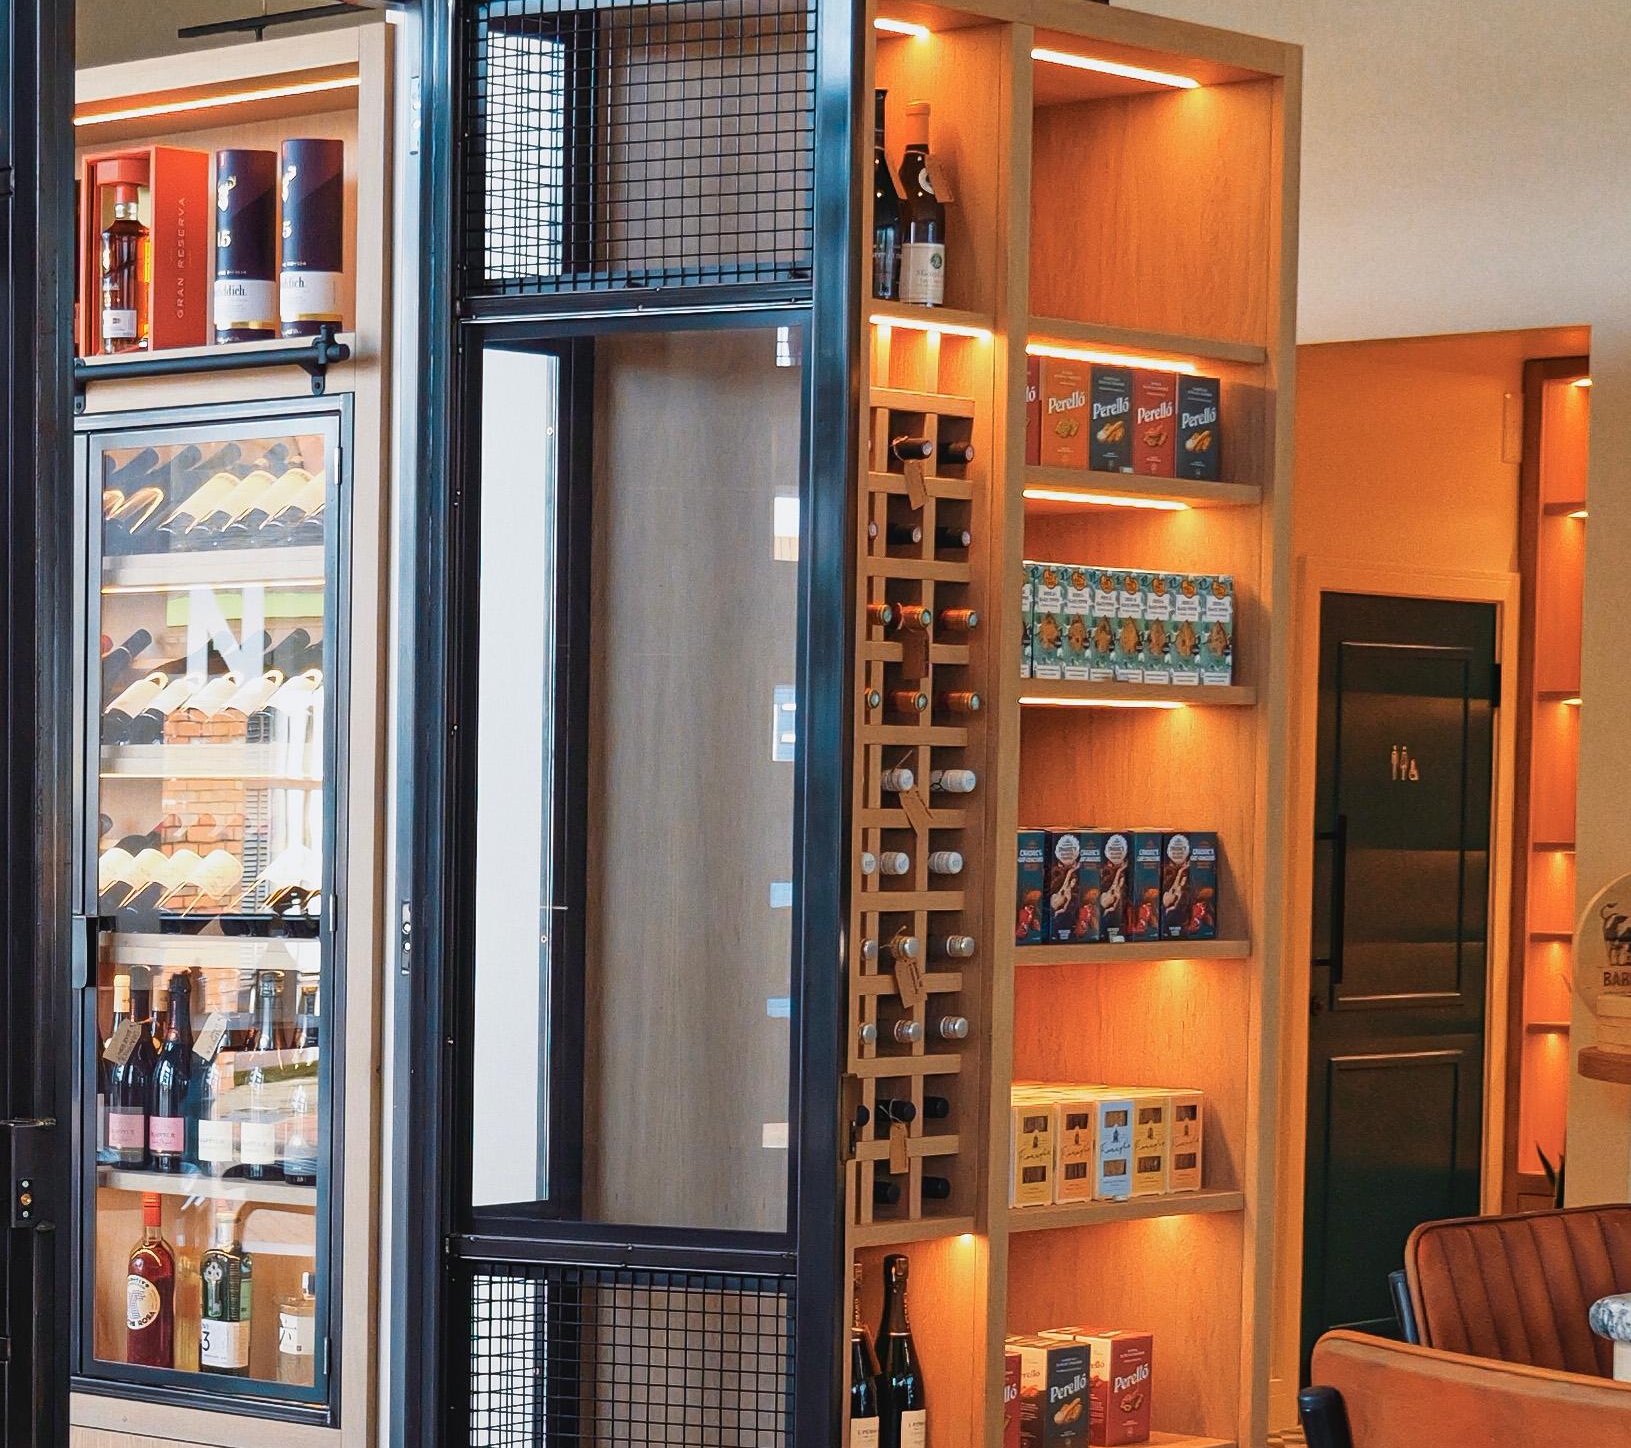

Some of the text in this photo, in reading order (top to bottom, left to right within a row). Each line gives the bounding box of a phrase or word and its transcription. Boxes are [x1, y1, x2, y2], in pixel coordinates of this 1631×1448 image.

[217, 229, 232, 248] 15
[282, 220, 293, 239] 5
[176, 198, 186, 319] GRAN RESERVA
[1048, 391, 1086, 414] Perelló
[1092, 397, 1130, 420] Perelló
[1137, 401, 1173, 424] Perelló
[1181, 408, 1217, 429] Perelló
[1050, 1373, 1087, 1404] Perelló
[1114, 1363, 1149, 1393] Perelló
